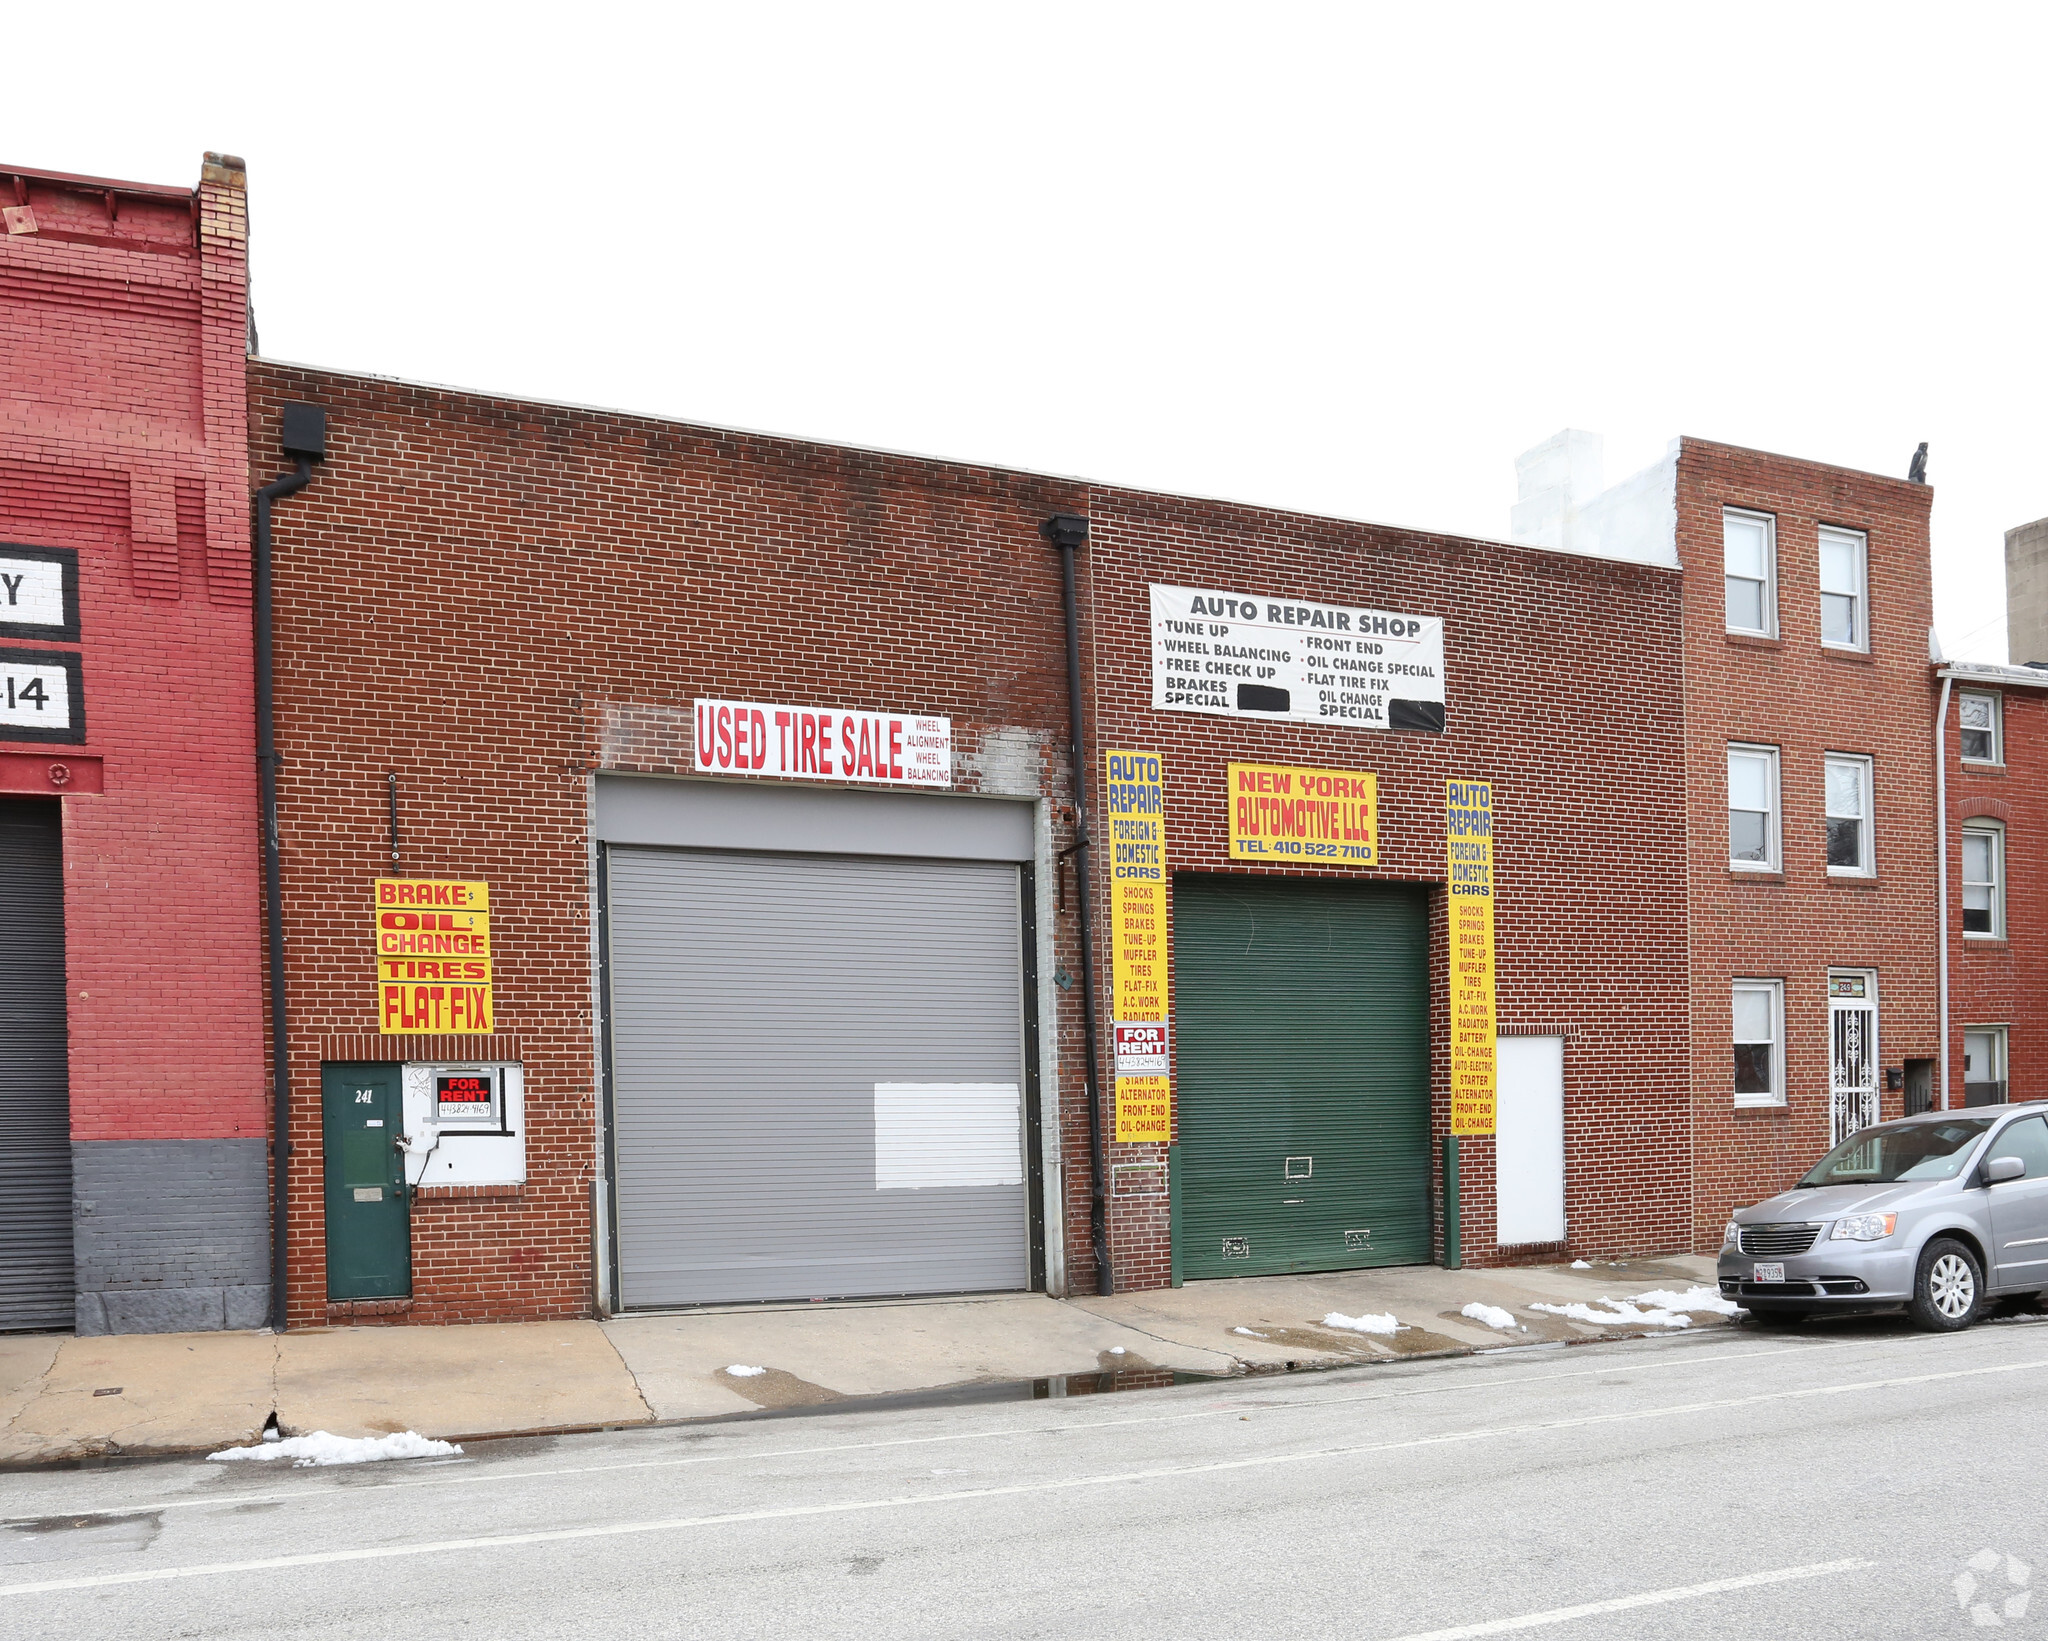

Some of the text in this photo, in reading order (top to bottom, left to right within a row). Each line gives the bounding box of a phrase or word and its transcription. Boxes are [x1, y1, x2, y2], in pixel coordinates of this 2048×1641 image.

[0, 573, 24, 605] Y
[1190, 596, 1421, 638] AUTO REPAIR SHOP
[1165, 620, 1229, 637] TUNE UP
[1164, 639, 1291, 663] WHEEL BALANCING
[1306, 636, 1383, 655] FRONT END
[1166, 658, 1276, 679] FREE CHECK UP
[1307, 655, 1435, 678] OIL CHANGE SPECIAL
[1166, 677, 1227, 693] BRAKES
[1307, 673, 1389, 691] FLAT TIRE FIX
[1165, 692, 1229, 708] SPECIAL
[1319, 690, 1383, 706] OIL CHANGE
[1319, 704, 1383, 720] SPECIAL
[915, 719, 941, 733] WHEEL
[698, 704, 903, 779] USED TIRE SALE
[906, 734, 949, 750] ALIGNMENT
[916, 752, 941, 765] WHEEL
[907, 767, 949, 783] BALANCING
[1109, 755, 1159, 782] AUTO
[1239, 771, 1366, 799] NEW YORK
[1109, 783, 1162, 814] REPAIR
[1449, 783, 1489, 808] AUTO
[1237, 796, 1369, 842] AUTOMOTIVE LLC
[1448, 808, 1491, 837] REPAIR
[1113, 820, 1149, 840] FOREIGN
[1116, 843, 1159, 864] DOMESTIC
[1451, 842, 1481, 861] FOREIGN
[1115, 866, 1160, 879] CARS
[1453, 863, 1489, 883] DOMESTIC
[380, 883, 474, 905] BRAKE $
[1123, 886, 1154, 899] SHOCKS
[1452, 884, 1490, 896] CARS
[1122, 902, 1154, 915] SPRINGS
[1460, 906, 1484, 917] SHOCKS
[381, 912, 474, 931] OIL $
[1124, 918, 1155, 930] BRAKES
[1459, 919, 1485, 931] SPRINGS
[381, 933, 485, 954] CHANGE
[1123, 933, 1157, 946] TUNE-UP
[1460, 934, 1484, 945] BRAKES
[1123, 949, 1157, 961] MUFFLER
[1459, 948, 1486, 959] TUNE-UP
[383, 961, 485, 979] TIRES
[1130, 965, 1152, 976] TIRES
[1459, 962, 1486, 973] MUFFLER
[1124, 980, 1158, 992] FLAT-FIX
[1463, 976, 1481, 987] TIRES
[1460, 990, 1487, 1001] FLAT-FIX
[384, 986, 488, 1029] FLAT-FIX
[1123, 1011, 1160, 1022] RADIATOR
[1458, 1018, 1488, 1029] RADIATOR
[1123, 1029, 1158, 1041] FOR
[1460, 1032, 1487, 1043] BATTERY
[1118, 1041, 1165, 1054] RENT
[1455, 1046, 1492, 1058] OIL-CHANGE
[1455, 1060, 1492, 1072] AUTO-ELECTRIC
[448, 1078, 480, 1090] FOR
[1125, 1076, 1159, 1085] STARTER
[1460, 1075, 1488, 1086] STARTER
[355, 1090, 372, 1103] 241
[440, 1090, 488, 1102] RENT
[1120, 1089, 1166, 1101] ALTERNATOR
[1455, 1089, 1493, 1100] ALTERNATOR
[1123, 1104, 1165, 1116] FRONT-END
[1456, 1103, 1491, 1114] FRONT-END
[1121, 1120, 1166, 1132] OIL-CHANGE
[1456, 1118, 1492, 1128] OIL-CHANGE
